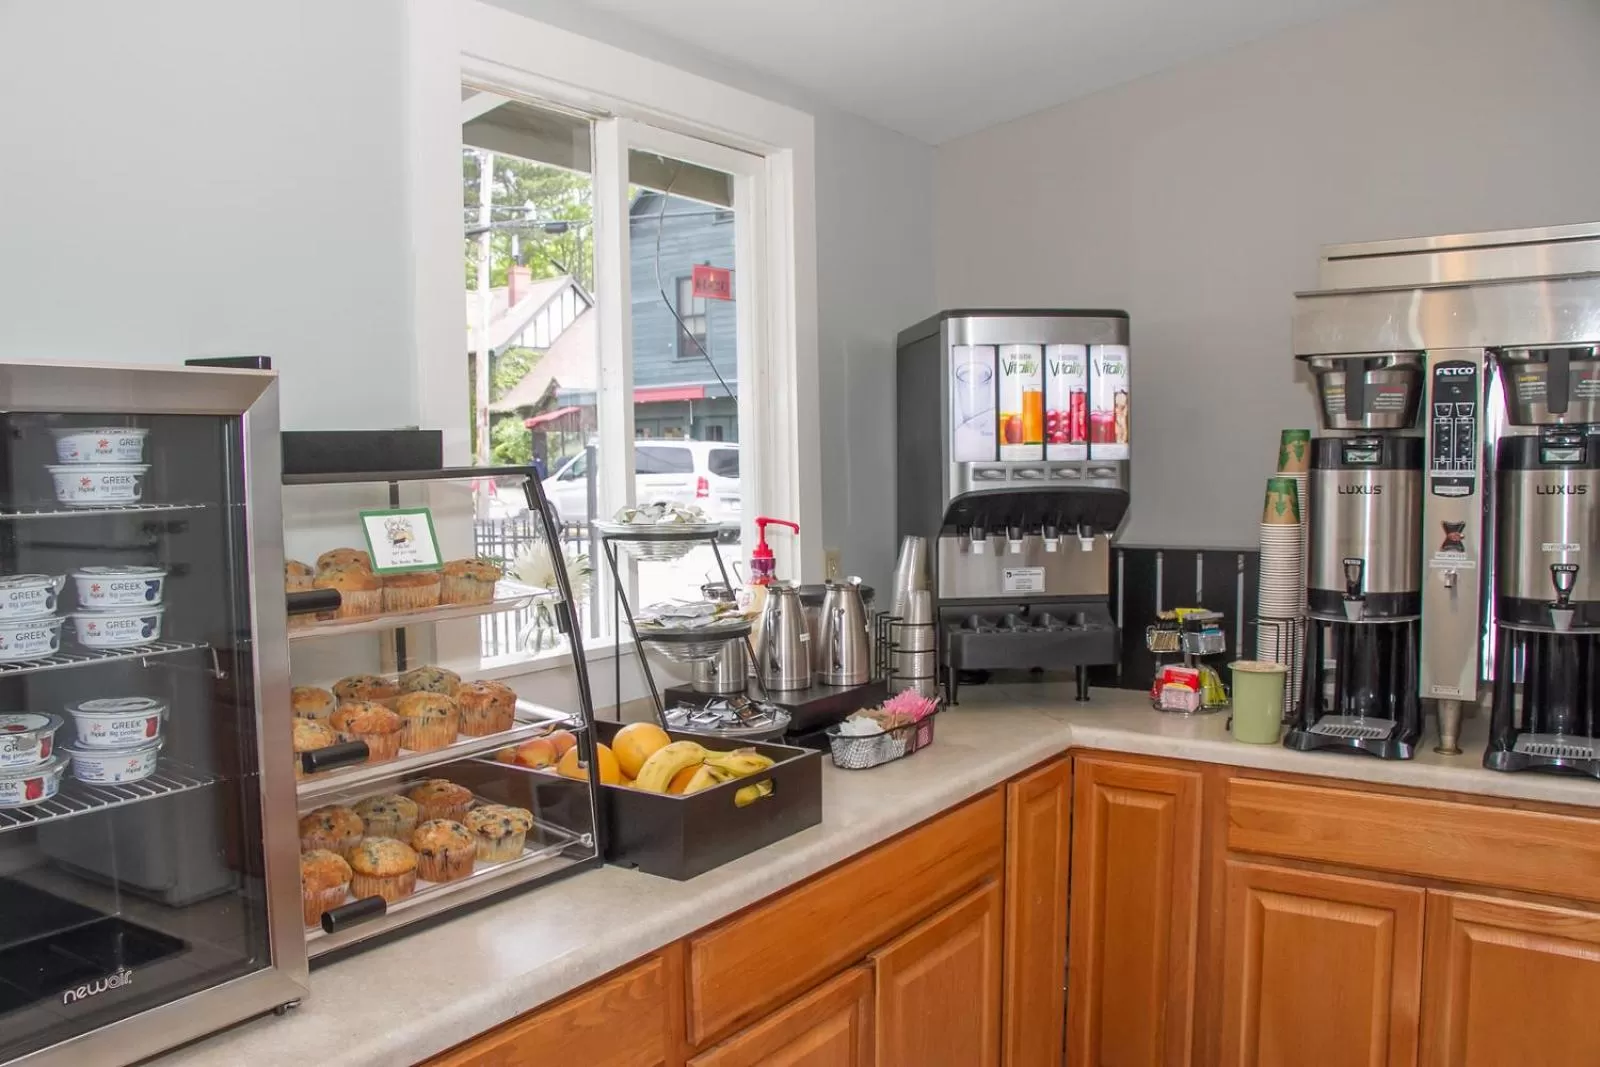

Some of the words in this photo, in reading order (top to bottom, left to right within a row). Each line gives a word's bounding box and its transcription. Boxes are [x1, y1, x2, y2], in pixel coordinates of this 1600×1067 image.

[102, 476, 131, 484] GREEK
[1338, 485, 1382, 495] LUXUS
[1536, 485, 1587, 495] LUXUS
[110, 582, 142, 591] GREEK
[10, 591, 42, 600] GREEK
[105, 621, 137, 629] GREEK
[15, 631, 47, 641] GREEK
[111, 720, 142, 730] GREEK
[63, 967, 132, 1004] newair
